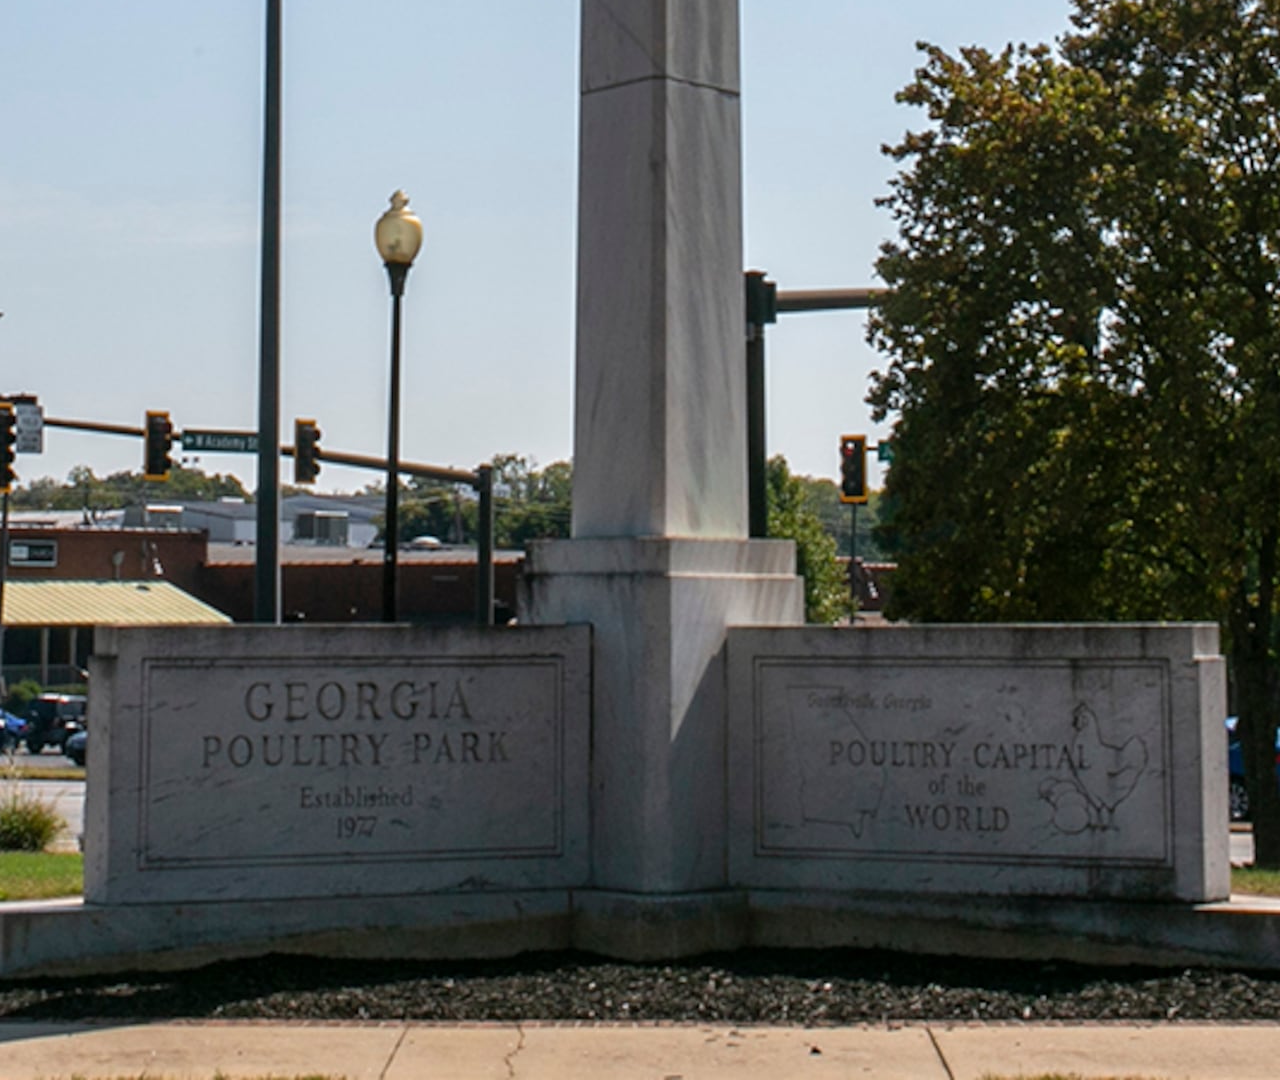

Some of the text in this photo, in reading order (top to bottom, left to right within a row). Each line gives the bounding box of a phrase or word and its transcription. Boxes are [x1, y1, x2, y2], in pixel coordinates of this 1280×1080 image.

[244, 681, 473, 721] GEORGIA
[202, 731, 513, 768] POULTRY PARK
[829, 740, 1092, 771] POULTRY CAPITAL
[300, 786, 414, 810] Established
[928, 776, 986, 798] of the
[337, 816, 378, 840] 1977
[905, 804, 1010, 833] WORLD
